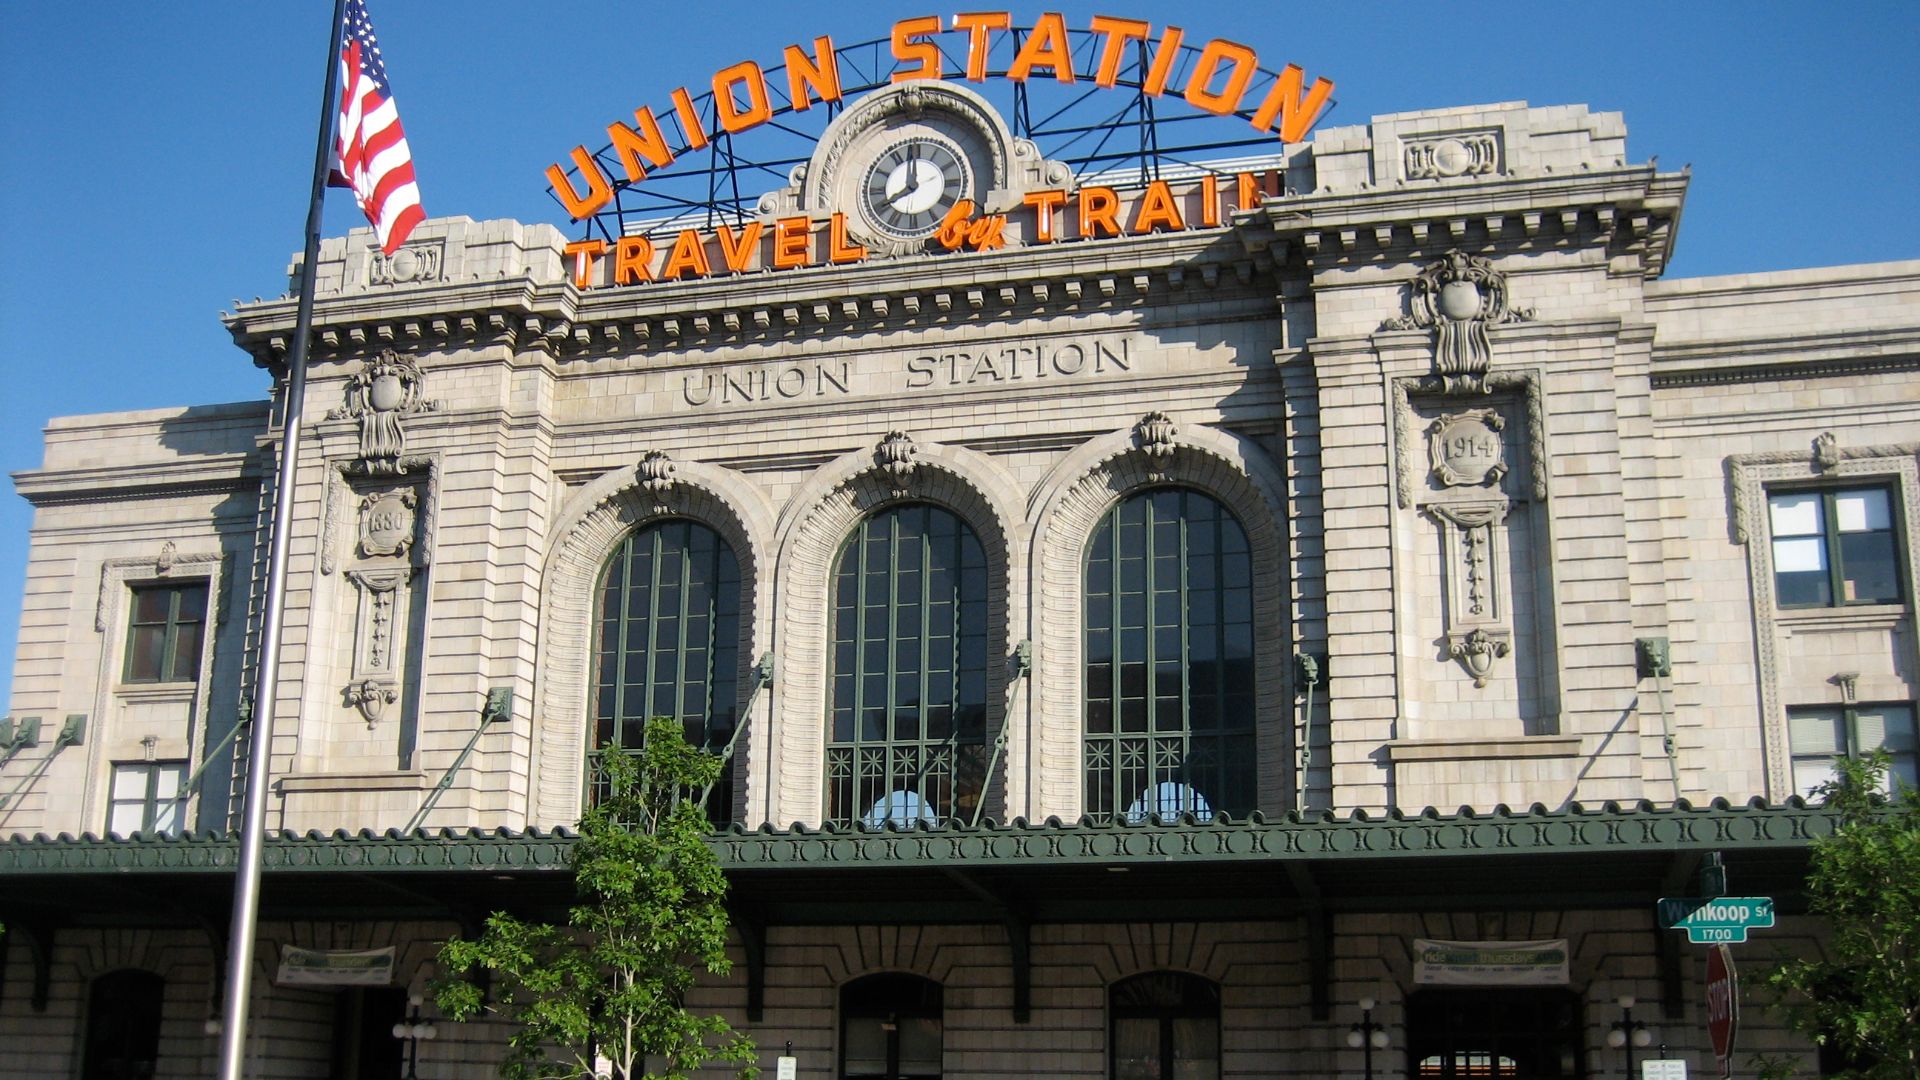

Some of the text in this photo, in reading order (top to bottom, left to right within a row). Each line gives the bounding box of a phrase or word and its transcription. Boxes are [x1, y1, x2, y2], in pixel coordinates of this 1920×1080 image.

[545, 12, 1335, 220] UNION STATION
[566, 212, 868, 290] TRAVEL
[682, 337, 1134, 406] UNION STATION
[1444, 436, 1493, 460] 1914
[1666, 902, 1768, 923] Wynkoop St
[1702, 929, 1732, 940] 1700
